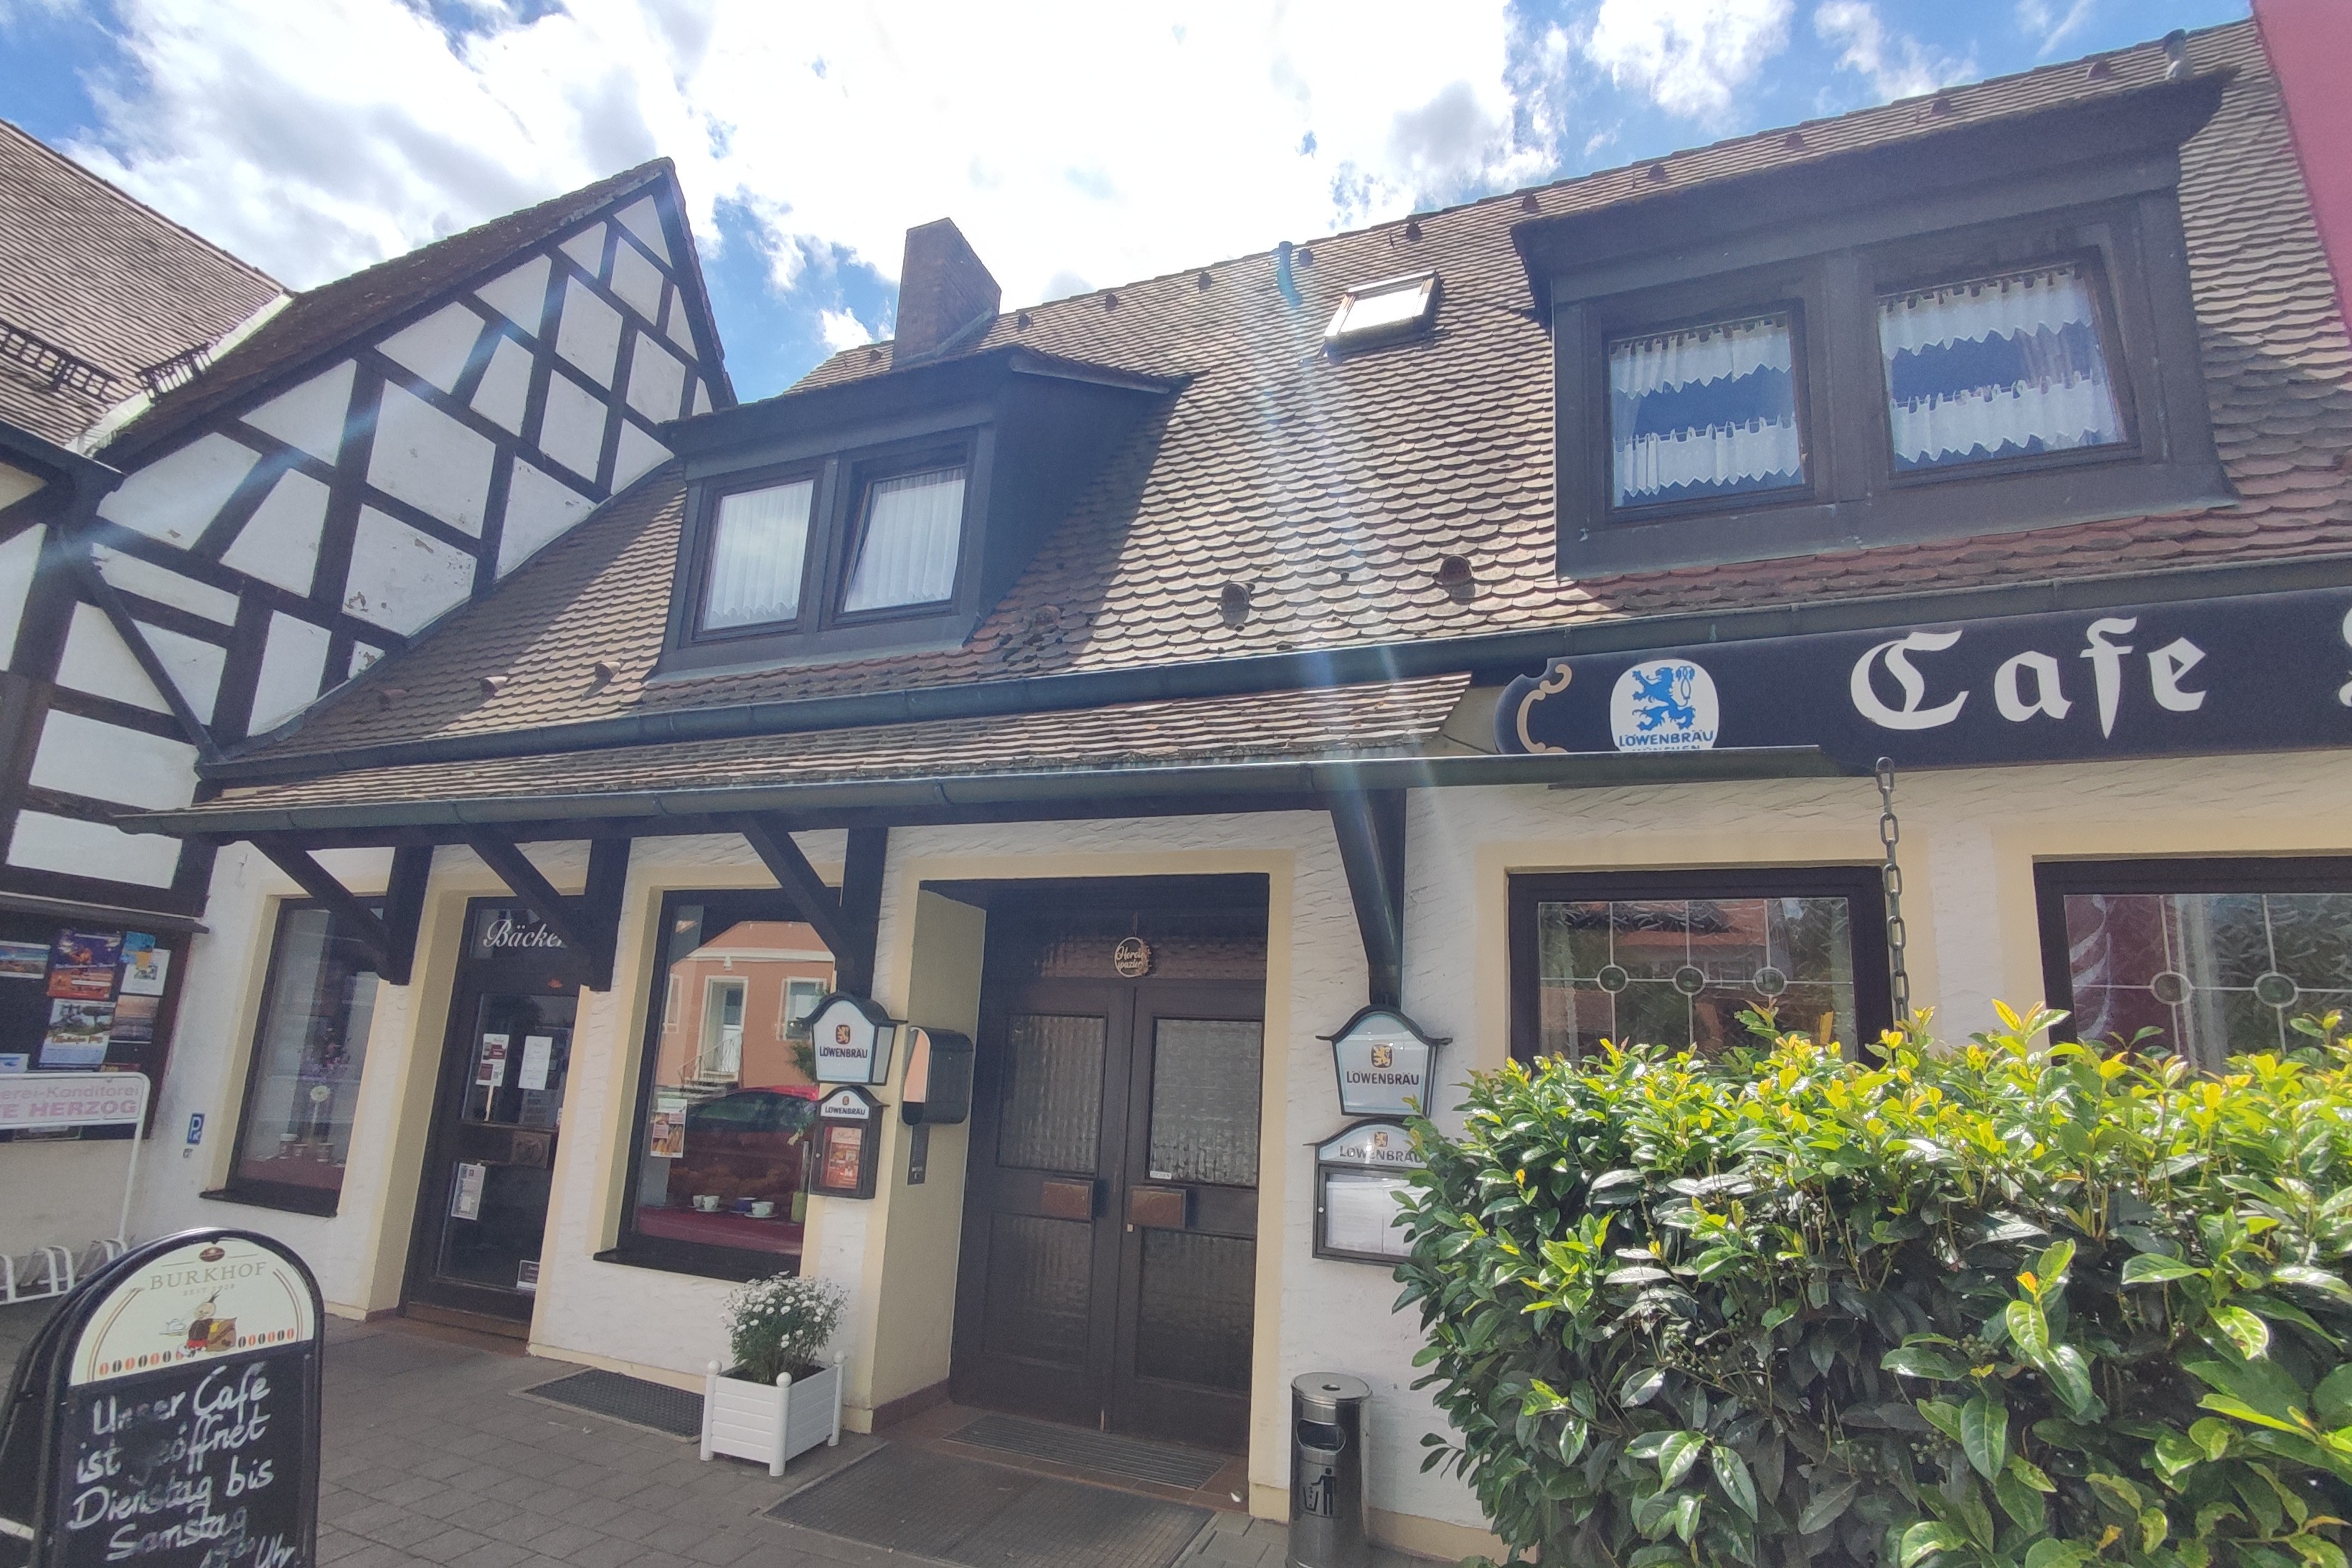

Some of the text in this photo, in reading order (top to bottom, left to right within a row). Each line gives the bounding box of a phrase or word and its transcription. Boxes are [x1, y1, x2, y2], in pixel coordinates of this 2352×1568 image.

[1851, 616, 2206, 740] Cafe
[1618, 729, 1714, 747] LÖWENBRÄU
[483, 919, 562, 948] Bäcke
[819, 1046, 868, 1058] LÖWENBRÄU
[1346, 1070, 1420, 1085] LÖWENBRÄU
[0, 1100, 137, 1118] E HERZOG
[825, 1105, 866, 1115] LÖWENBRÄU
[150, 1262, 267, 1290] BURKHOF
[193, 1361, 271, 1425] Cafe
[76, 1402, 271, 1484] ist eöffnet
[225, 1455, 274, 1497] bis
